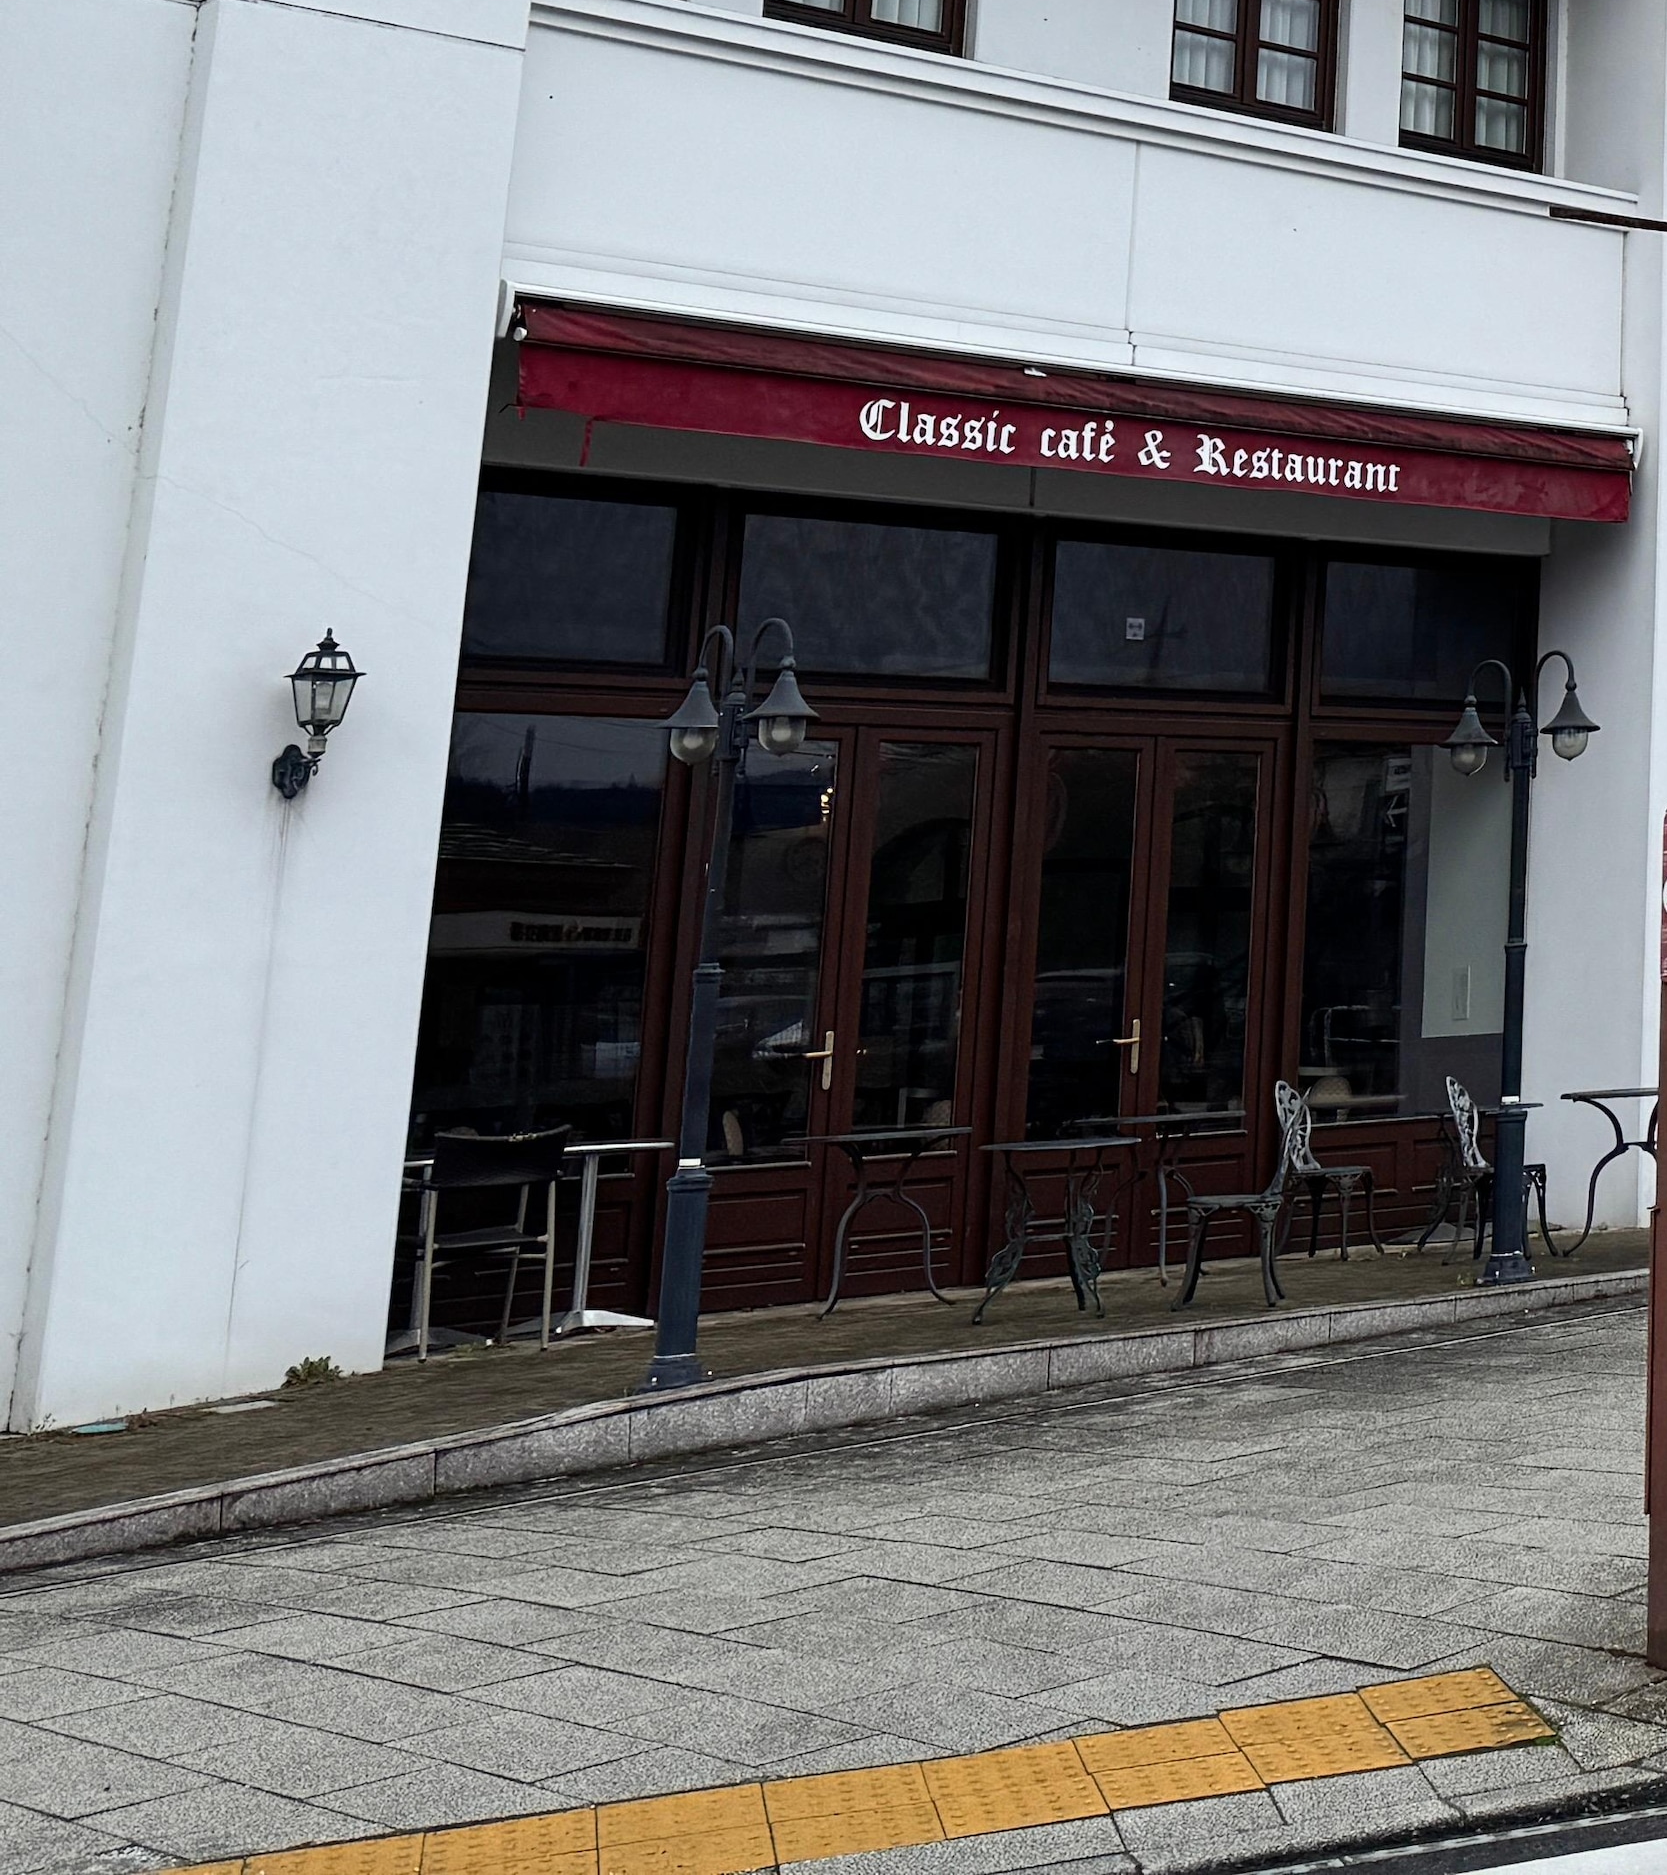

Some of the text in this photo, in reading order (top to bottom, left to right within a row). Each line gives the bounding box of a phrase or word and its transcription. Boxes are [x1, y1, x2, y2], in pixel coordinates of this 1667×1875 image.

[859, 399, 1016, 454] Classic
[1137, 429, 1172, 470] &
[1193, 433, 1401, 493] Restaurant
